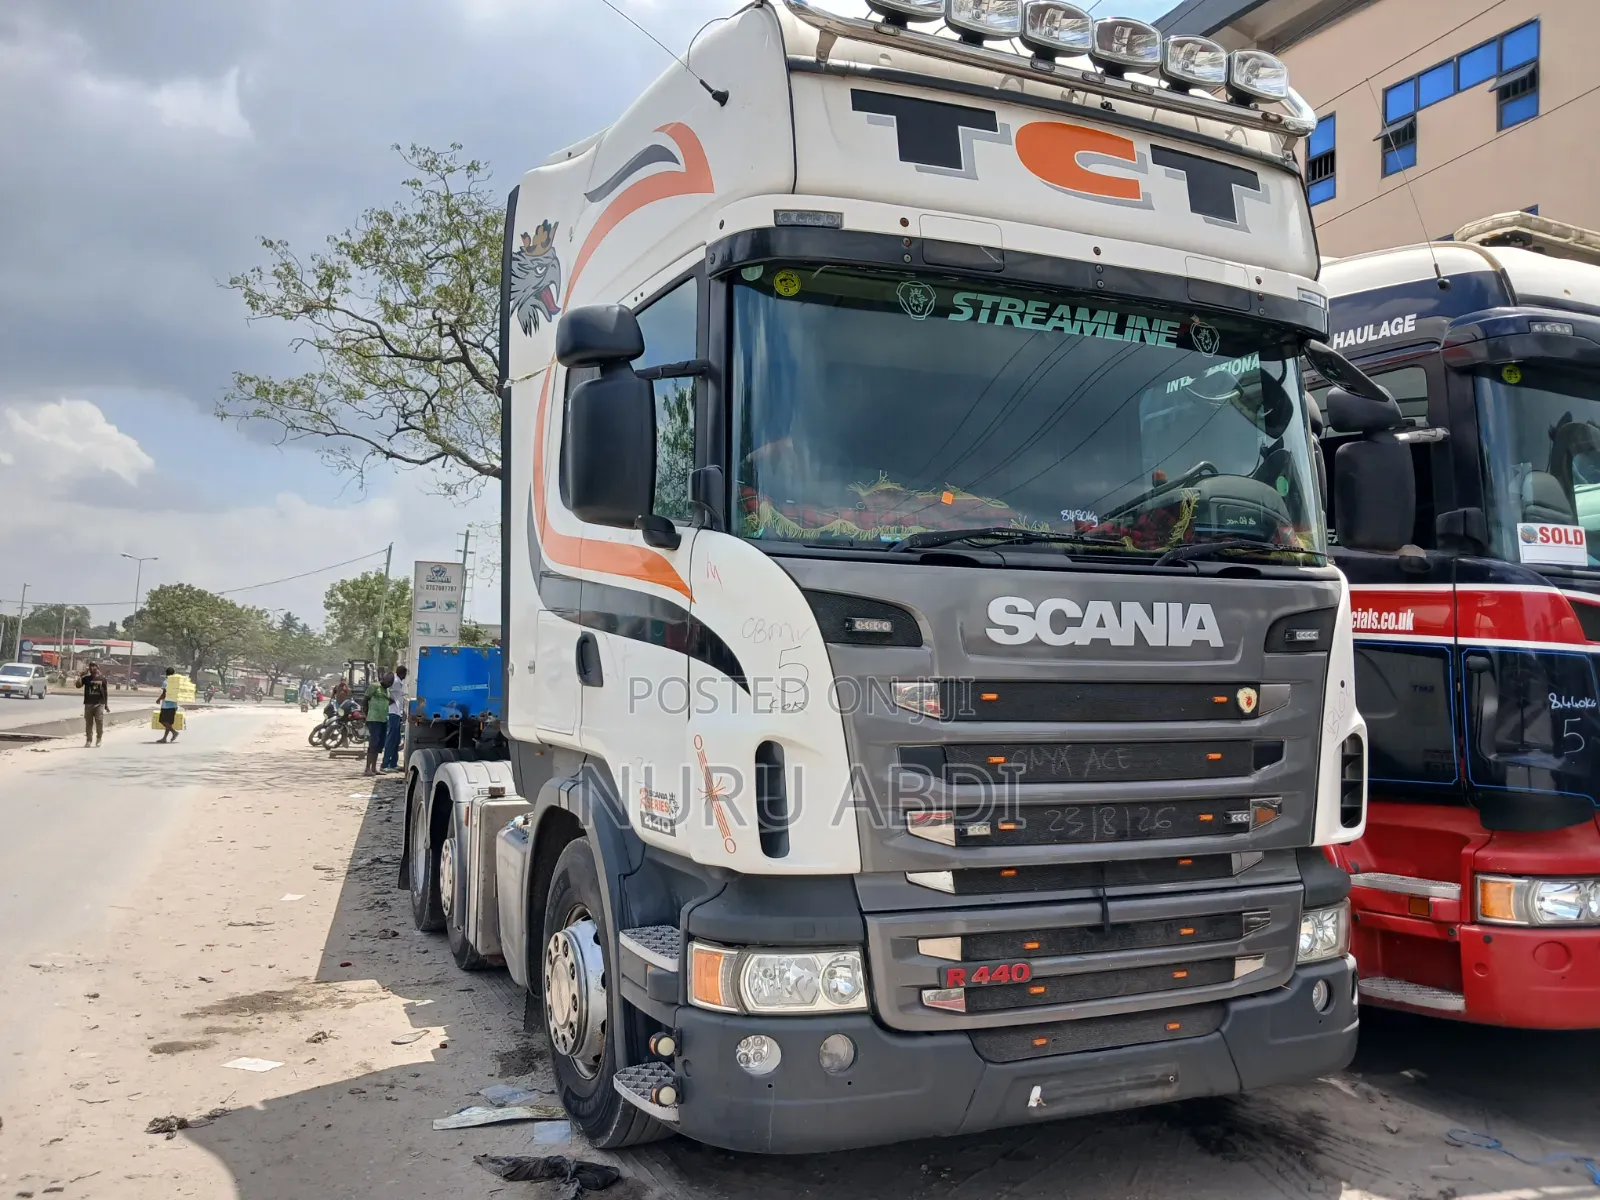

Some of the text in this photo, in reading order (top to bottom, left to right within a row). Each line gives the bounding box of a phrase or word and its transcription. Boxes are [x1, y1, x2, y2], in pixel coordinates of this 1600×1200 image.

[850, 88, 1272, 234] TCT
[947, 291, 1182, 350] STREAMLINE
[1332, 313, 1417, 350] HAULAGE
[1539, 526, 1584, 546] SOLD
[985, 596, 1224, 648] SCANIA
[1563, 717, 1585, 754] 5
[647, 798, 669, 812] SERIES
[648, 790, 668, 800] SCANIA
[644, 815, 671, 833] 440
[947, 962, 1031, 988] R 440
